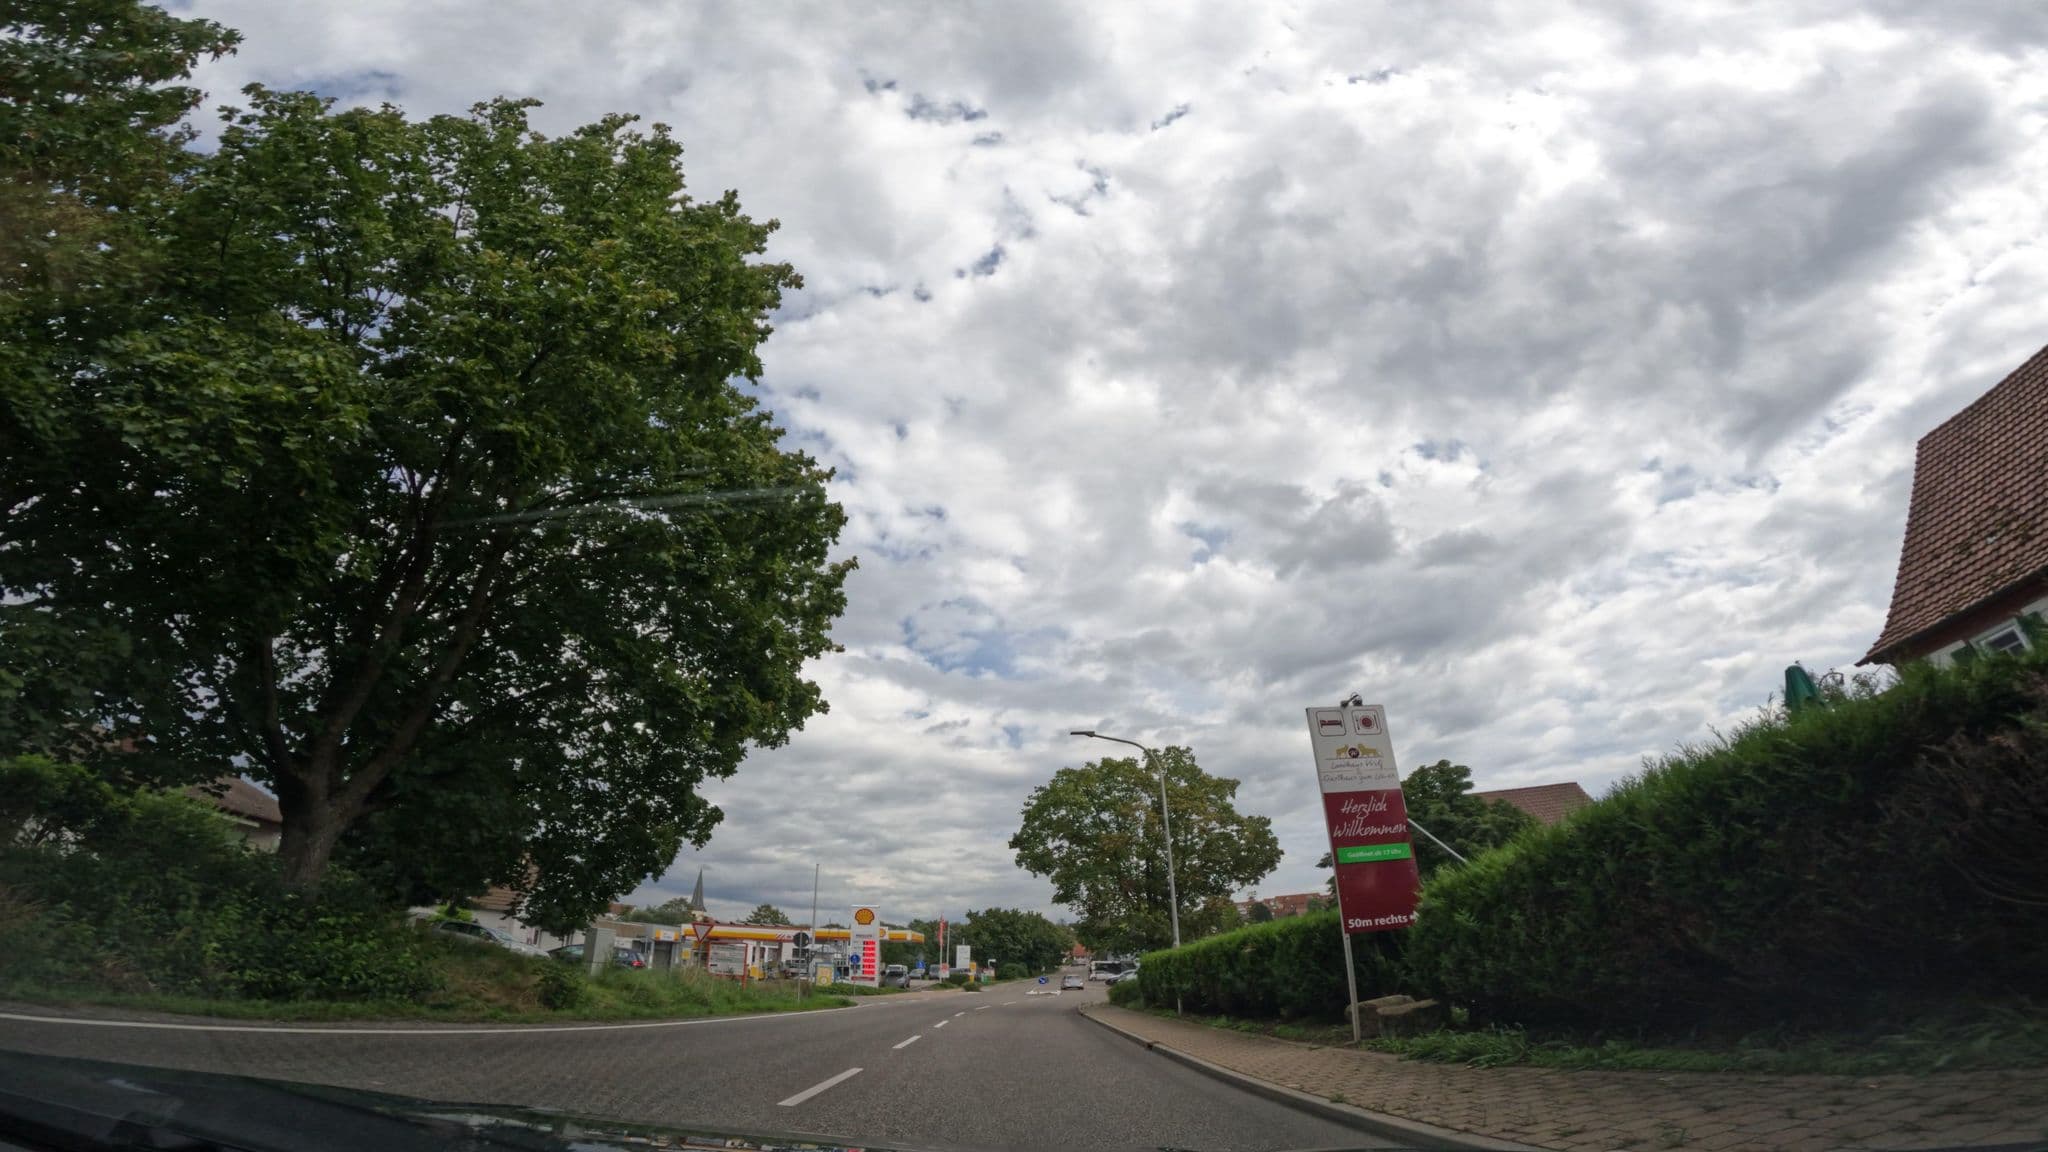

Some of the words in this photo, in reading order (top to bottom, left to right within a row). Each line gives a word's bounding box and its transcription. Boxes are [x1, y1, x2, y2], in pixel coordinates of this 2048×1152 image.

[1340, 793, 1387, 820] Herzlich
[1333, 818, 1408, 837] Willkommen
[1348, 918, 1373, 928] 50m
[1375, 914, 1408, 926] rechts
